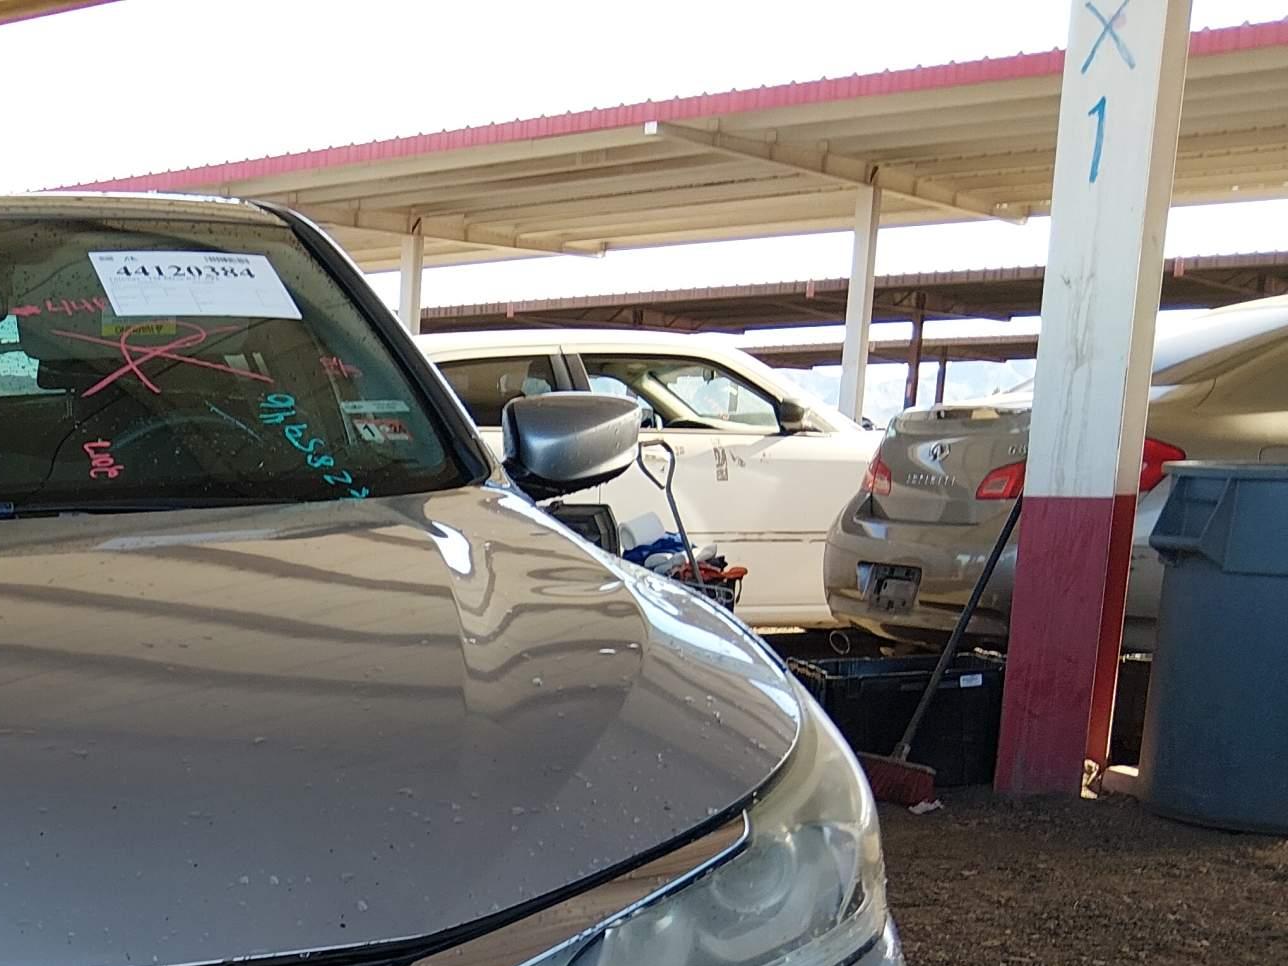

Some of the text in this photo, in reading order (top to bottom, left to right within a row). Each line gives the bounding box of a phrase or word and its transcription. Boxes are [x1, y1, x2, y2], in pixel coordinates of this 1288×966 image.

[1081, 0, 1136, 75] X
[1088, 96, 1106, 183] 1
[116, 265, 255, 279] 44120384
